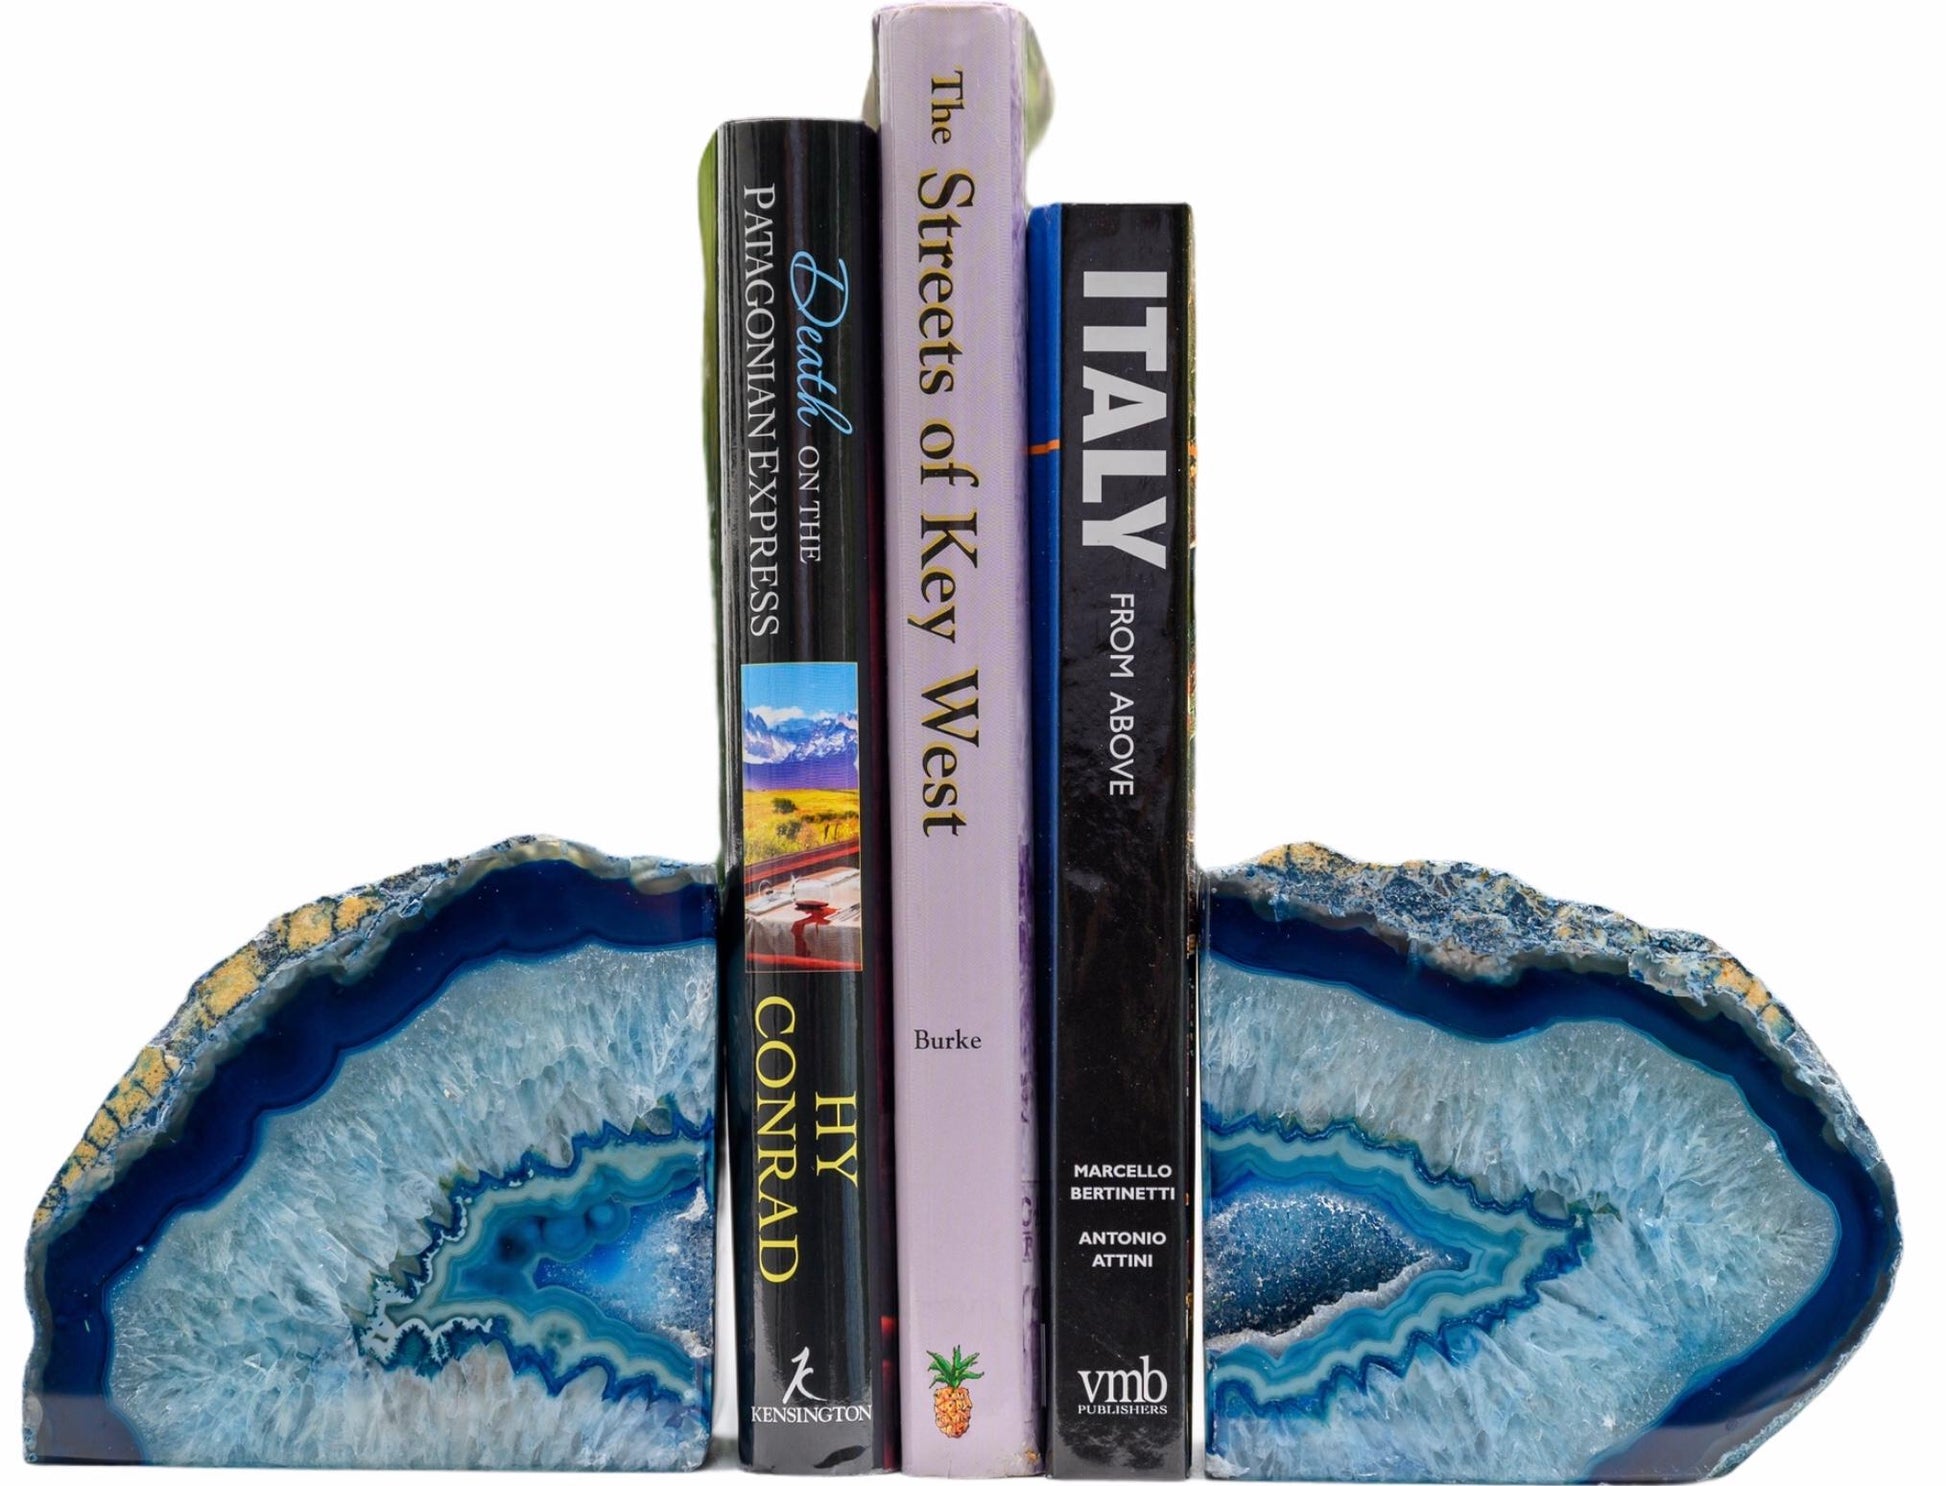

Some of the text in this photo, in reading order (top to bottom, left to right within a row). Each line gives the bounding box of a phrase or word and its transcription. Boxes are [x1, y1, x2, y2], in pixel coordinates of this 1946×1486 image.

[742, 183, 780, 638] PATAGONIAN EXPRESS
[789, 250, 853, 564] Death ON THE
[1082, 271, 1168, 570] ITALY
[907, 66, 980, 837] The Streets of Key West
[1109, 592, 1136, 798] FROM ABOVE
[913, 1029, 983, 1051] Burke
[754, 995, 800, 1283] CONRAD
[814, 1090, 859, 1189] HY
[1070, 1187, 1176, 1202] BERTINETTI
[1073, 1163, 1173, 1179] MARCELLO
[1078, 1230, 1168, 1247] ANTONIO
[1091, 1254, 1154, 1269] ATTINI
[1077, 1355, 1168, 1404] vmb
[751, 1405, 873, 1423] KENSINGTON
[1077, 1404, 1168, 1415] PUBLISHERS
